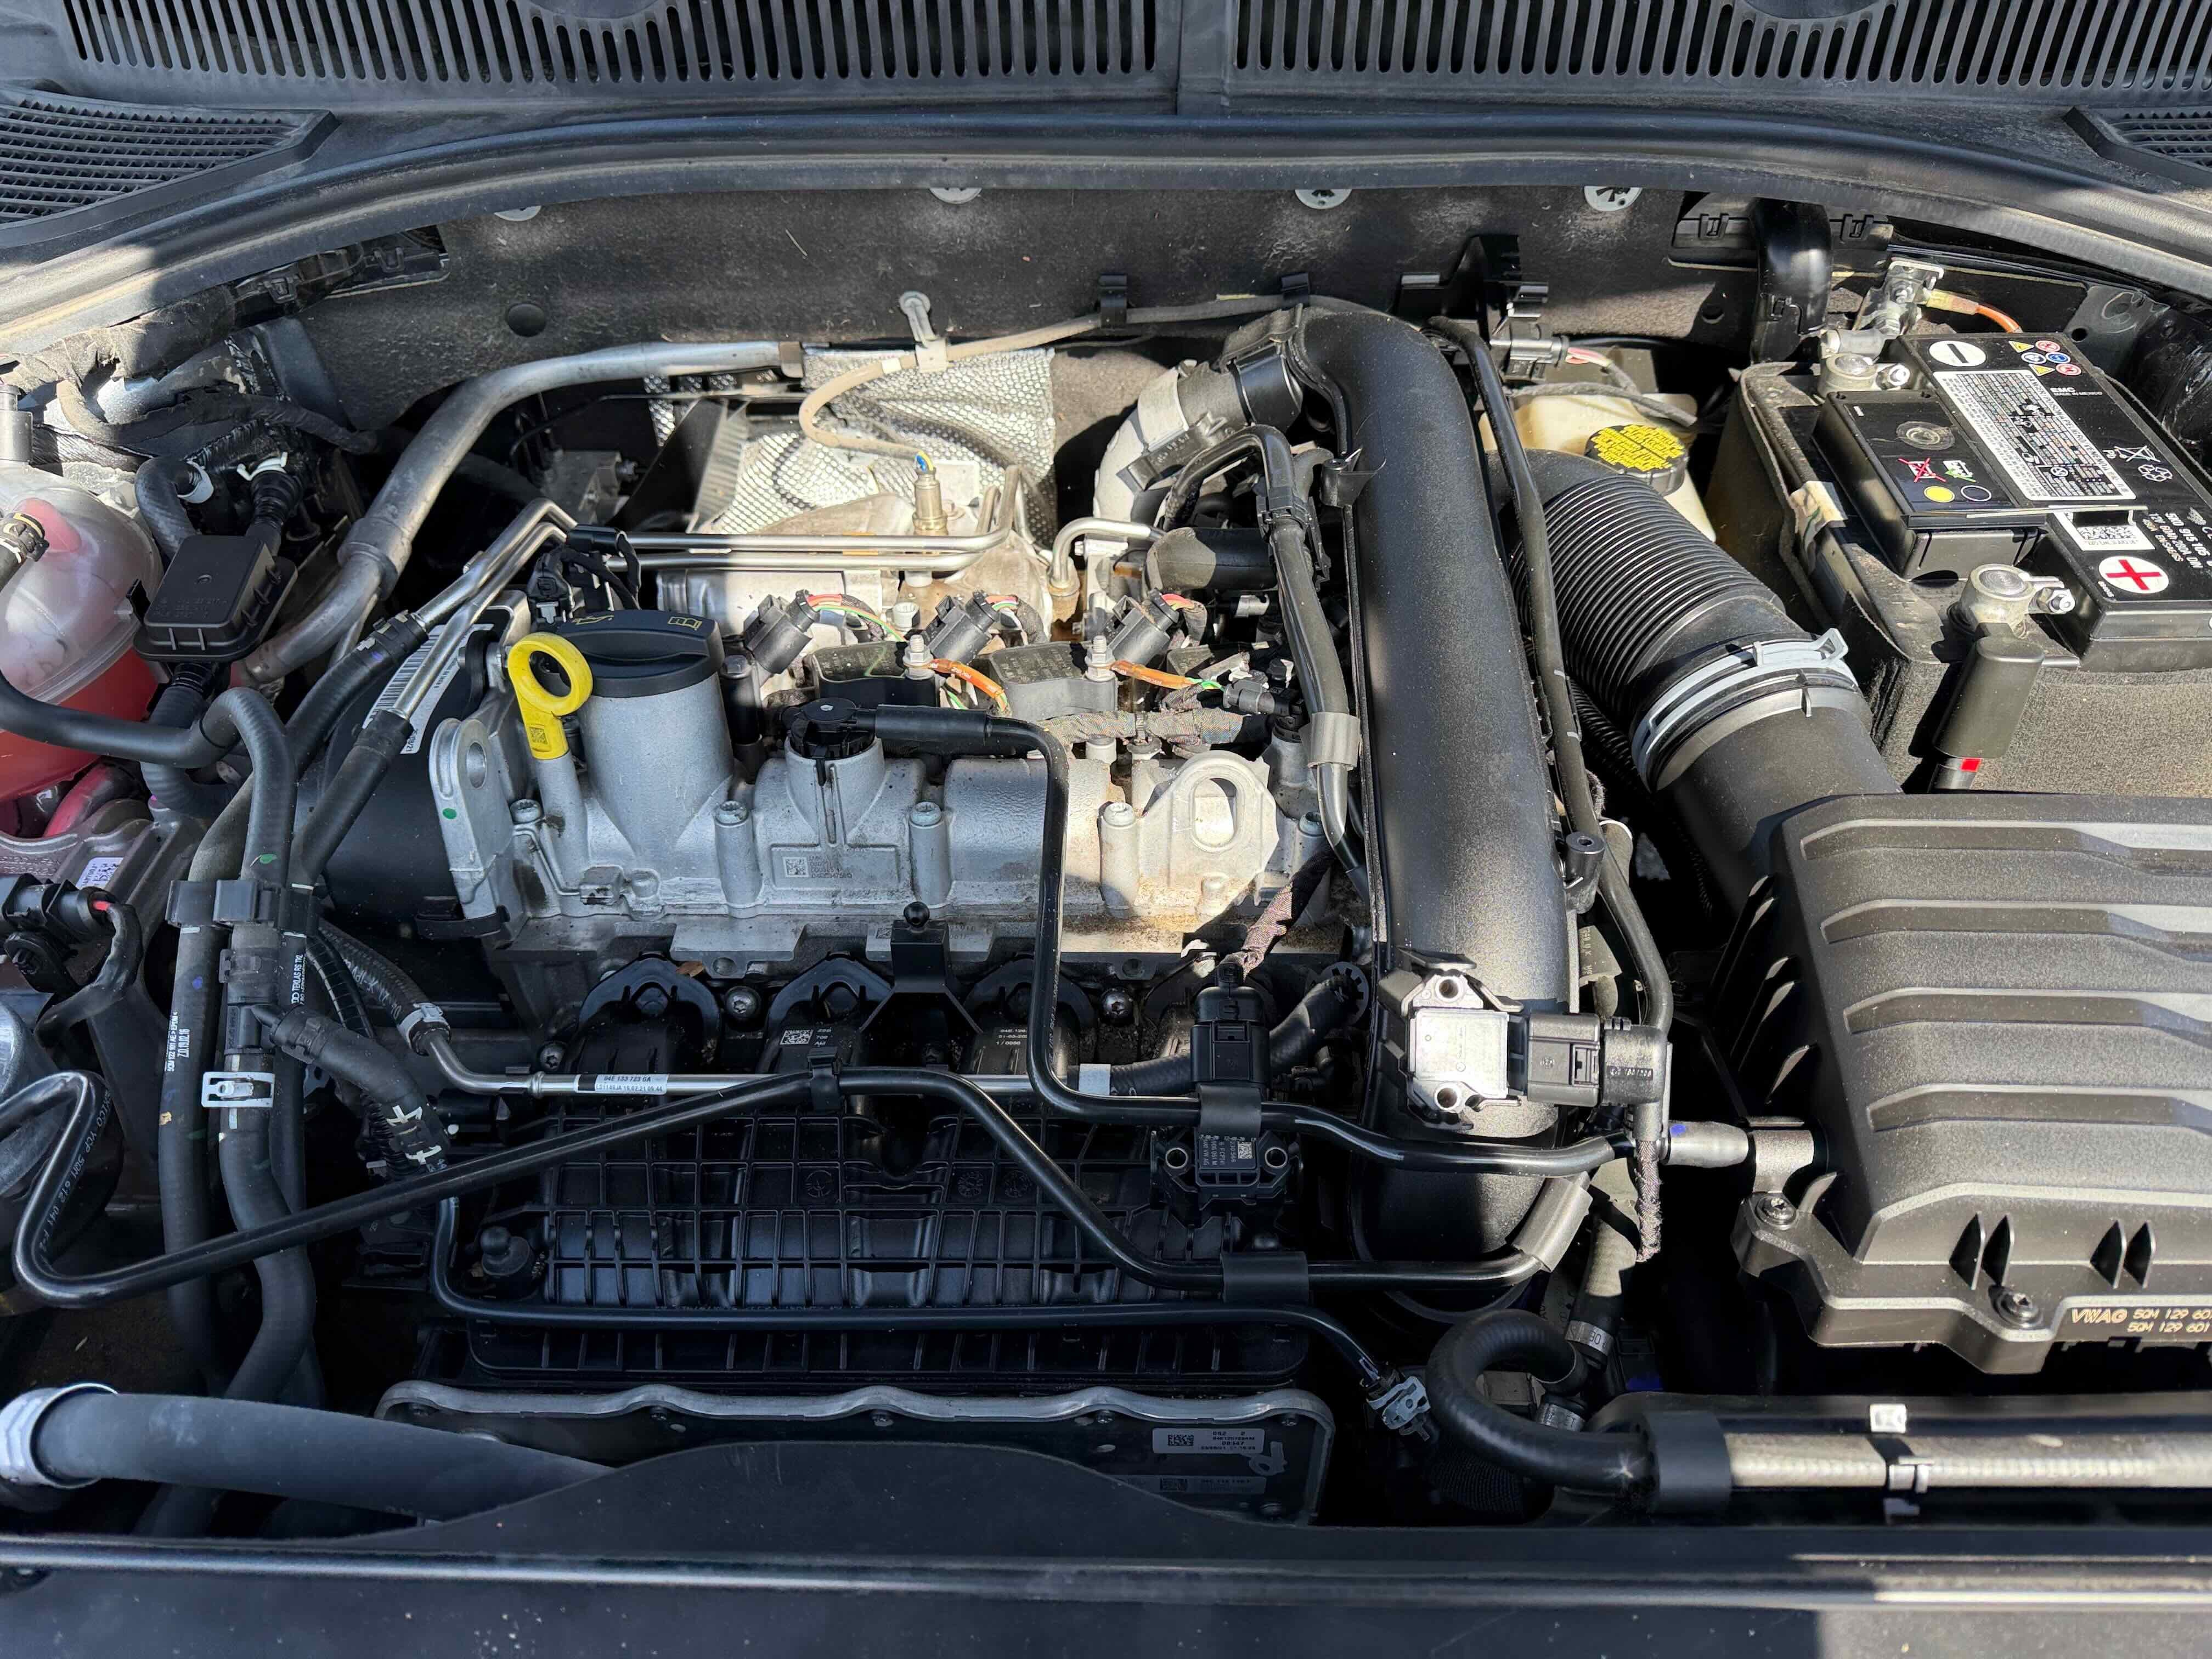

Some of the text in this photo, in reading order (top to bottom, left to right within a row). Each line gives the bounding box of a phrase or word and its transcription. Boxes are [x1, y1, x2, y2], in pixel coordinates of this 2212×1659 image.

[2179, 528, 2198, 541] 915
[2192, 542, 2210, 556] 105
[2186, 557, 2203, 568] DIN
[2072, 1308, 2128, 1323] VWAG
[2165, 1308, 2189, 1319] 129
[2159, 1321, 2183, 1333] 129
[2186, 1321, 2210, 1333] 601
